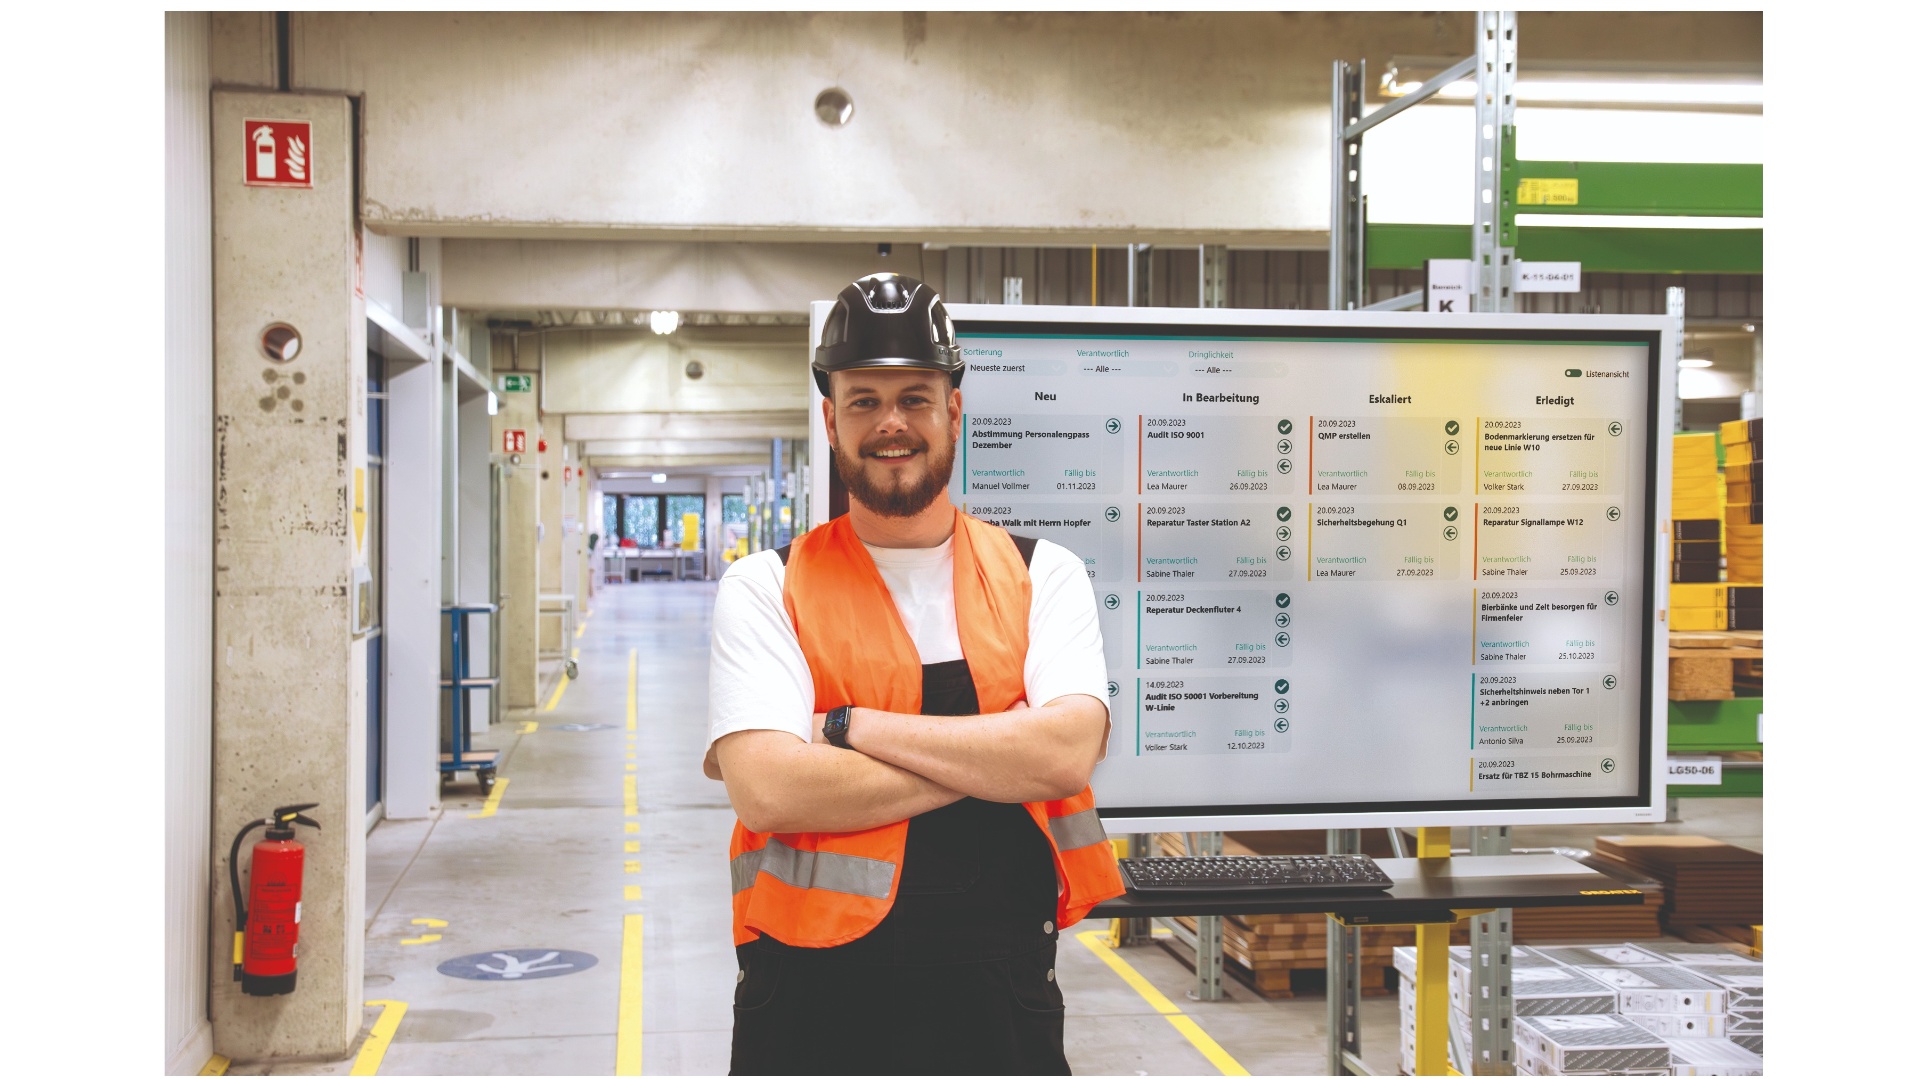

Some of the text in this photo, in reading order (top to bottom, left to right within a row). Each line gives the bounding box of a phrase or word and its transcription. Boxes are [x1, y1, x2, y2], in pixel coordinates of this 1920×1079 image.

[1439, 299, 1454, 313] K
[963, 348, 1003, 358] Sortierung
[1076, 348, 1129, 358] Verantwortlich
[1188, 350, 1234, 360] Dringlichkeit
[970, 364, 1026, 372] Neueste zuerst
[1095, 364, 1110, 373] Alle
[1206, 366, 1221, 374] Alle
[1585, 370, 1630, 378] Listenansicht
[1034, 391, 1057, 401] Neu
[1182, 392, 1260, 405] In Bearbeitung
[1369, 394, 1412, 404] Eskaliert
[1535, 395, 1575, 407] Erledigt
[972, 418, 1012, 426] 20.09.2023
[1147, 419, 1186, 427] 20.09.2023
[1318, 419, 1356, 428] 20.09.2023
[1484, 421, 1522, 429] 20.09.2023
[972, 430, 1090, 440] Abstimmung Personalengpass
[1147, 431, 1205, 439] Audit ISO 9001
[1318, 432, 1371, 441] QMP erstellen
[1484, 433, 1595, 442] Bodenmarkierung ersetzen für
[1504, 443, 1522, 451] Linie
[1523, 443, 1540, 451] W10
[972, 469, 1025, 477] Verantwortlich
[1064, 469, 1096, 478] Fällig bis
[1147, 469, 1199, 477] Verantwortlich
[1237, 469, 1268, 478] Fällig bis
[1317, 470, 1368, 478] Verantwortlich
[1405, 470, 1436, 479] Fällig bis
[1483, 470, 1533, 478] Verantwortlich
[1569, 470, 1599, 479] Fällig bis
[972, 482, 1030, 490] Manuel Vollmer
[1056, 482, 1096, 490] 01.11.2023
[1161, 482, 1188, 490] Maurer
[1229, 482, 1268, 490] 26.09.2023
[1317, 483, 1357, 491] Lea Maurer
[1397, 483, 1435, 491] 08.09.2023
[1483, 483, 1524, 491] Volker Stark
[1562, 483, 1599, 491] 27.09.2023
[971, 506, 1012, 515] 20.09.2023
[1146, 506, 1186, 515] 20.09.2023
[1317, 506, 1355, 515] 20.09.2023
[1483, 506, 1520, 514] 20.09.2023
[1002, 519, 1021, 527] Walk
[1023, 519, 1037, 527] mit
[1038, 519, 1062, 527] Herrn
[1063, 519, 1091, 528] Hopfer
[1146, 518, 1251, 528] Reparatur Taster Station A2
[1316, 518, 1407, 528] Sicherheitsbegehung Q1
[1483, 518, 1584, 528] Reparatur Signallampe W12
[1085, 557, 1096, 565] bis
[1146, 556, 1198, 564] Verantwortlich
[1236, 556, 1267, 565] Fällig bis
[1316, 556, 1367, 564] Verantwortlich
[1404, 556, 1434, 565] Fällig bis
[1482, 555, 1532, 563] Verantwortlich
[1567, 555, 1597, 564] Fällig bis
[1146, 570, 1195, 578] Sabine Thaler
[1228, 569, 1267, 577] 27.09.2023
[1316, 569, 1356, 577] Lea Maurer
[1396, 568, 1434, 577] 27.09.2023
[1482, 568, 1528, 576] Sabine Thaler
[1560, 568, 1597, 576] 25.09.2023
[1146, 594, 1185, 602] 20.09.2023
[1146, 607, 1184, 615] Reperatur
[1186, 606, 1235, 614] Deckenfluter
[1481, 603, 1518, 611] Bierbänke
[1519, 603, 1534, 611] und
[1551, 603, 1585, 612] besorgen
[1586, 602, 1598, 611] für
[1481, 614, 1523, 622] Firmenfeier
[1235, 643, 1266, 652] Fällig bis
[1480, 640, 1530, 648] Verantwortlich
[1565, 639, 1595, 648] Fällig bis
[1146, 644, 1198, 652] Verantwortlich
[1227, 656, 1266, 664] 27.09.2023
[1480, 653, 1526, 661] Sabine Thaler
[1558, 652, 1595, 660] 25.10.2023
[1145, 657, 1194, 665] Sabine Thaler
[1480, 676, 1517, 684] 20.09.2023
[1145, 681, 1184, 689] 14.09.2023
[1479, 688, 1547, 696] Sicherheitshinweis
[1548, 687, 1571, 695] neben
[1572, 687, 1585, 695] Tor
[1145, 692, 1259, 701] Audit ISO 50001 Vorbereitung
[1491, 698, 1529, 708] anbringen
[1145, 704, 1175, 712] W-Linie
[1479, 724, 1528, 733] Verantwortlich
[1564, 723, 1594, 732] Fällig bis
[1145, 730, 1197, 738] Verantwortlich
[1234, 729, 1265, 738] Fällig bis
[1479, 737, 1524, 745] Antonio Silva
[1556, 736, 1593, 744] 25.09.2023
[1145, 743, 1188, 751] Volker Stark
[1227, 742, 1265, 750] 12.10.2023
[1478, 760, 1515, 769] 20.09.2023
[1478, 771, 1592, 780] Ersatz für TBZ 15 Bohrmaschine
